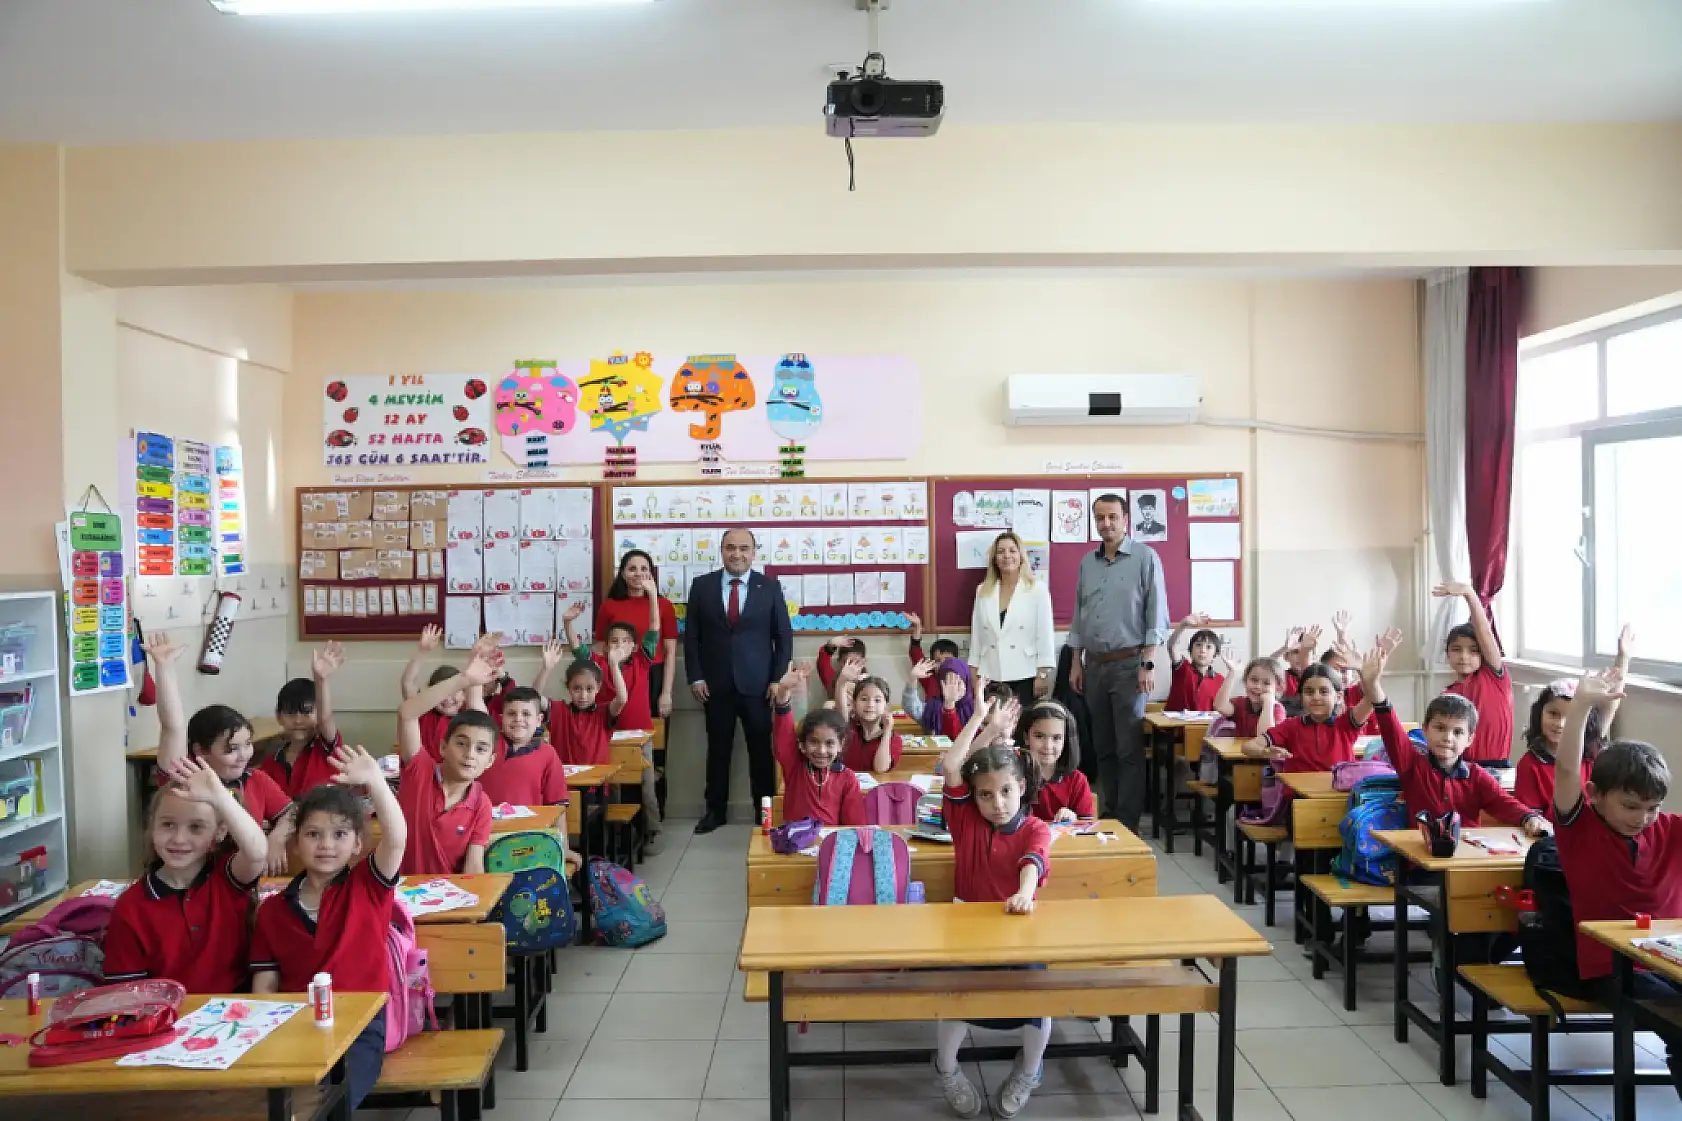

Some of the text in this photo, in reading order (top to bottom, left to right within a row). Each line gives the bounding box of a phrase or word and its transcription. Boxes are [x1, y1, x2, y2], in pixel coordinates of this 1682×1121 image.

[401, 375, 425, 386] YIL
[368, 390, 444, 406] 4 MEVSİM
[383, 413, 429, 426] 12 AY
[368, 432, 444, 446] 52 HAFTA
[326, 453, 353, 466] 365
[357, 450, 390, 466] GÜN
[395, 453, 405, 465] 6
